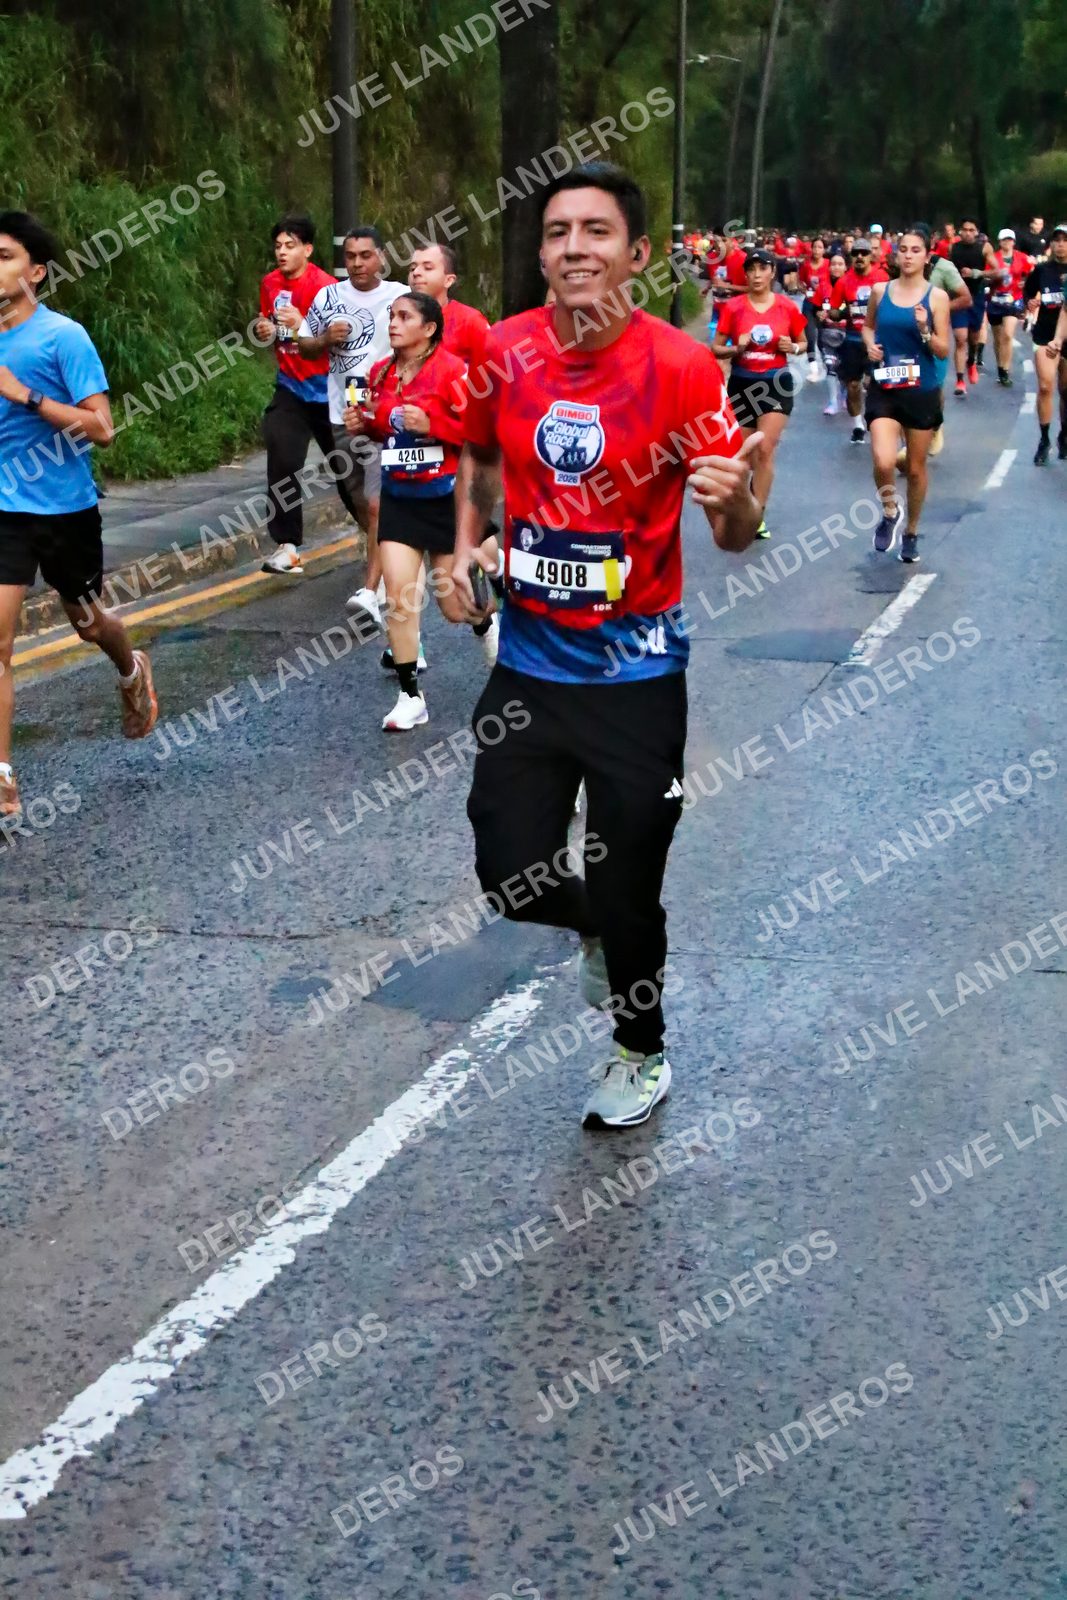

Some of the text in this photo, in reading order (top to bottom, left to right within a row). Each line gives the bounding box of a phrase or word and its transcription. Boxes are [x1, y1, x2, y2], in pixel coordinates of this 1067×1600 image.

[886, 366, 907, 378] 5080
[556, 408, 592, 421] BIMBO
[554, 422, 590, 438] Global
[545, 431, 574, 447] Race
[398, 448, 424, 462] 4240
[557, 473, 578, 483] 2026
[535, 559, 587, 588] 4908
[592, 604, 612, 612] 10K
